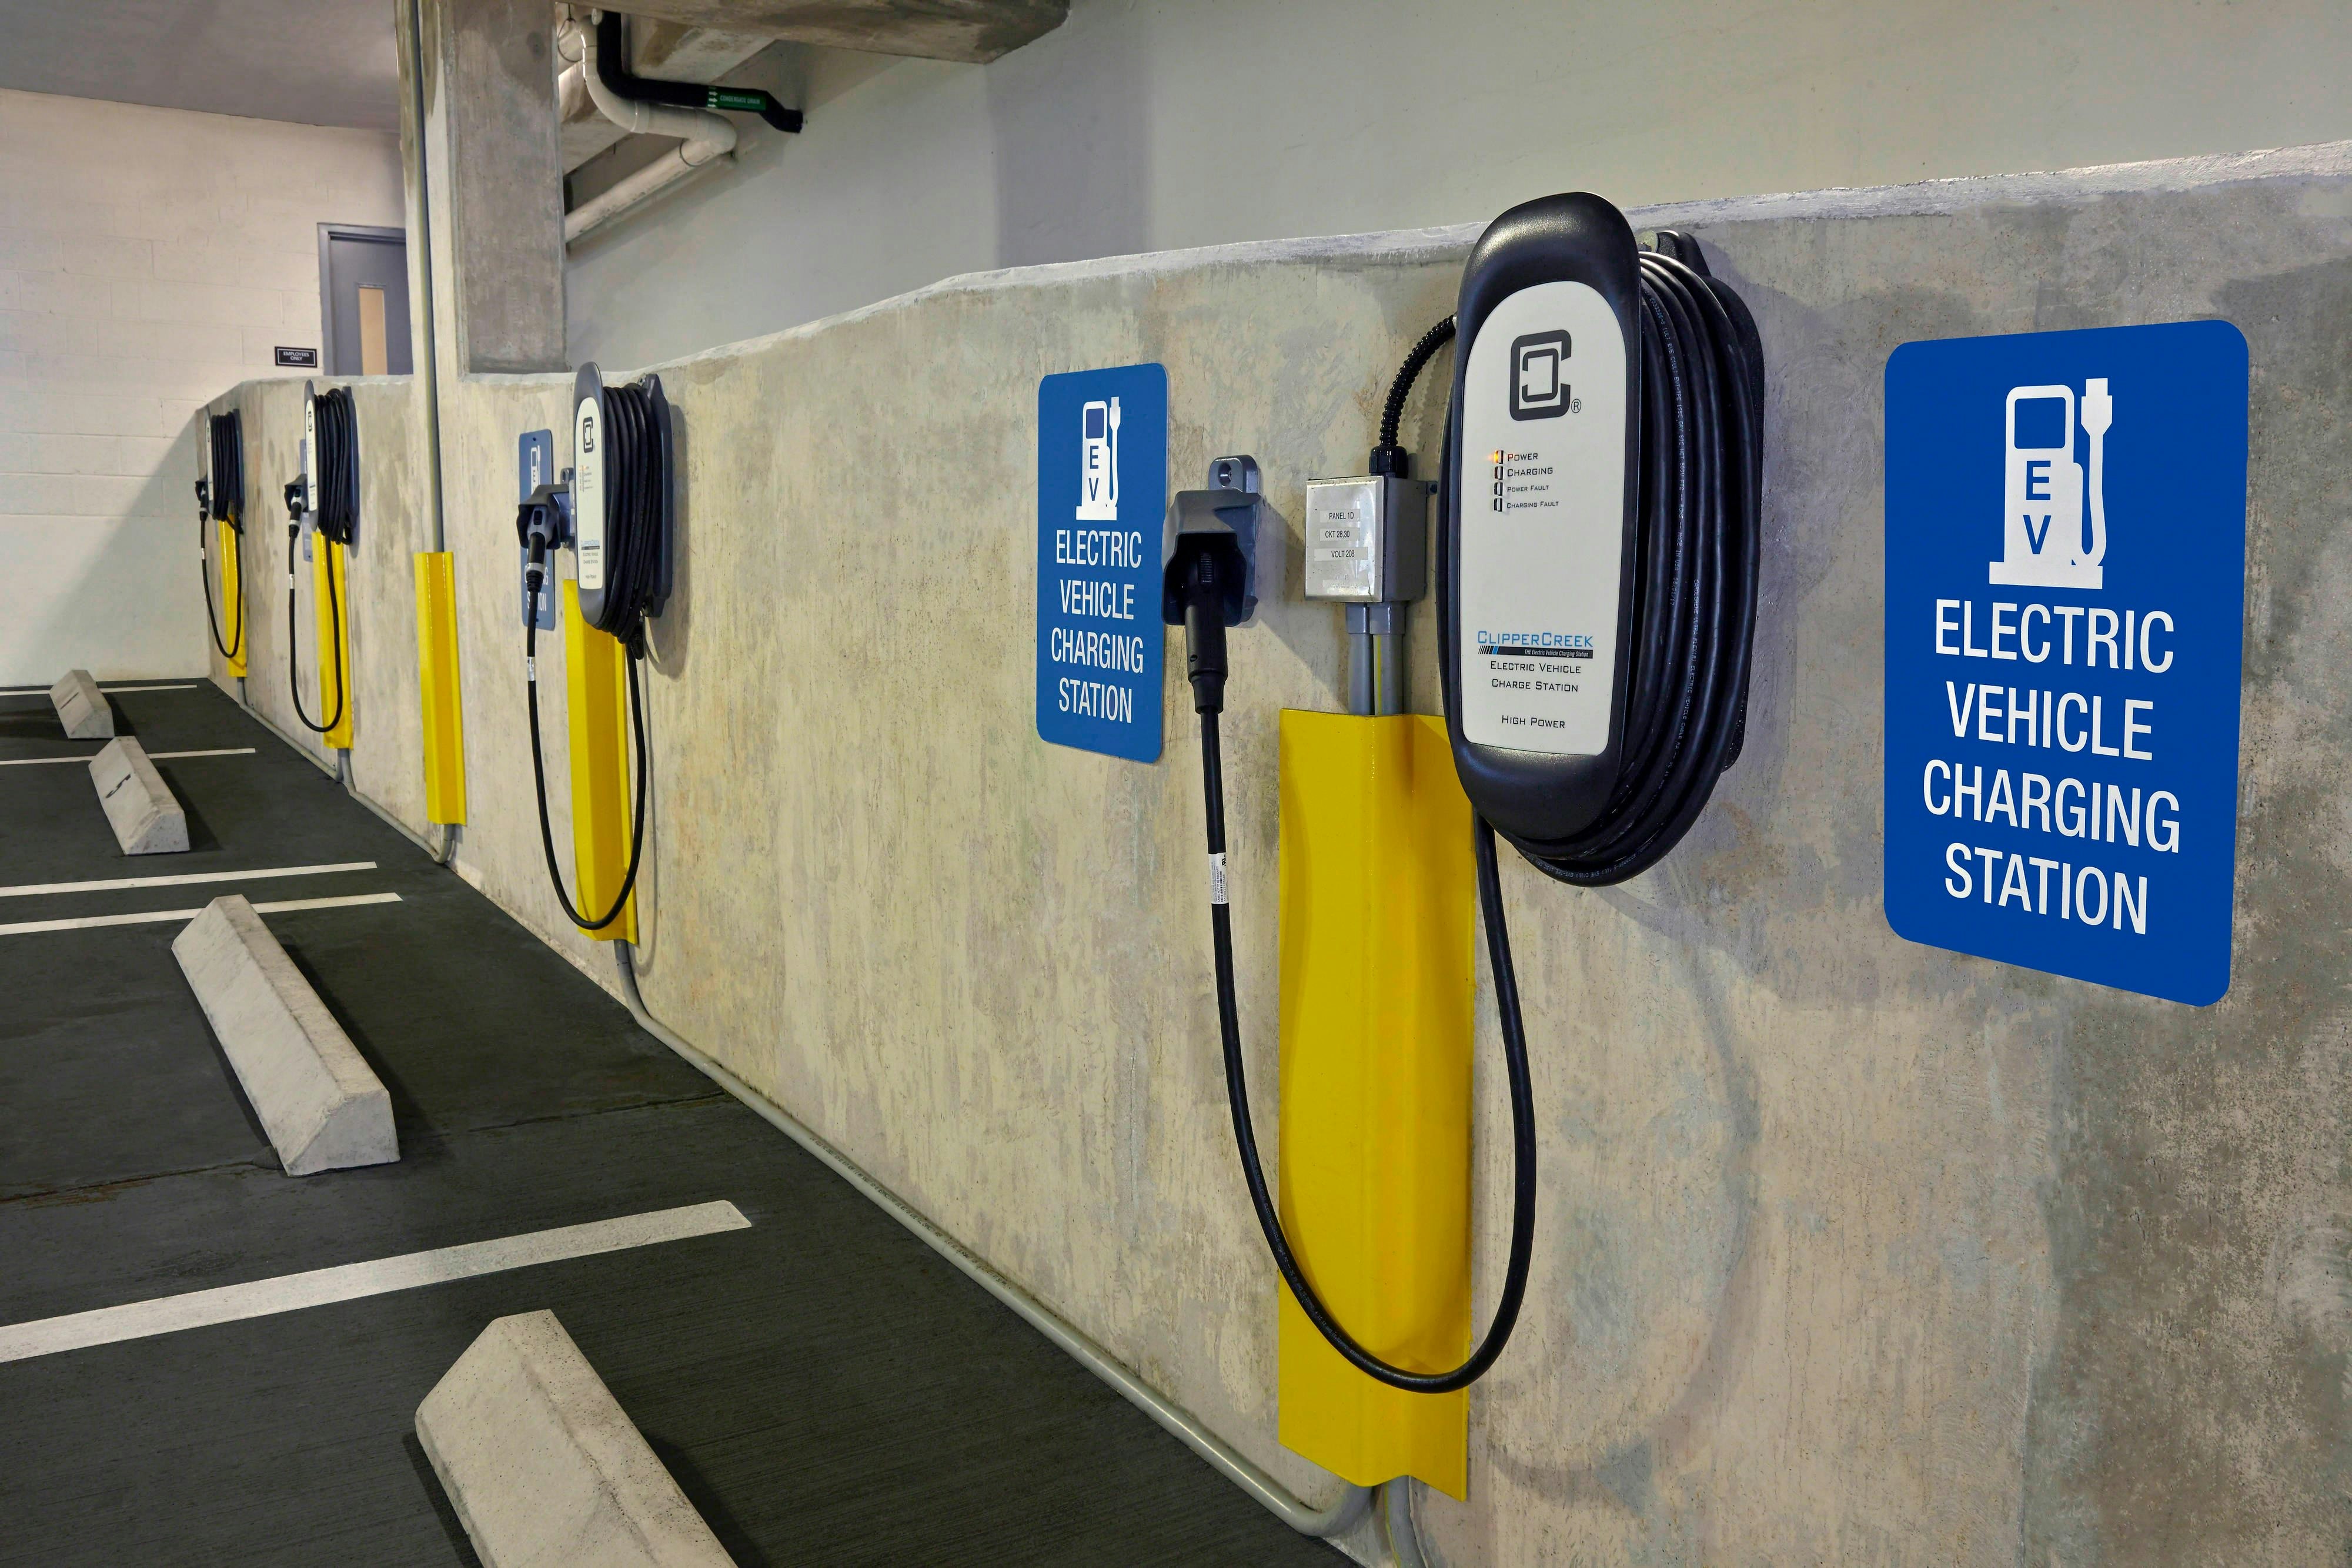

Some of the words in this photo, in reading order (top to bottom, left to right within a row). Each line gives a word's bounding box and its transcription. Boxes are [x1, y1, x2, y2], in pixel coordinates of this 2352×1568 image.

[1507, 452, 1539, 462] POWER
[1507, 467, 1553, 477] CHARGING
[1329, 512, 1346, 520] PANEL
[1056, 529, 1142, 569] ELECTRIC
[1060, 579, 1134, 620] VEHICLE
[1051, 627, 1144, 674] CHARGING
[1936, 599, 2174, 675] ELECTRIC
[1491, 661, 1535, 671] ELECTRIC
[1539, 663, 1581, 674] VEHICLE
[1492, 678, 1531, 690] CHARGE
[1535, 681, 1578, 692] STATION
[1058, 677, 1132, 723] STATION
[1502, 715, 1526, 726] HIGH
[1531, 717, 1565, 728] POWER
[1946, 681, 2154, 761] VEHICLE
[1923, 760, 2180, 854] CHARGING
[1945, 842, 2148, 935] STATION
